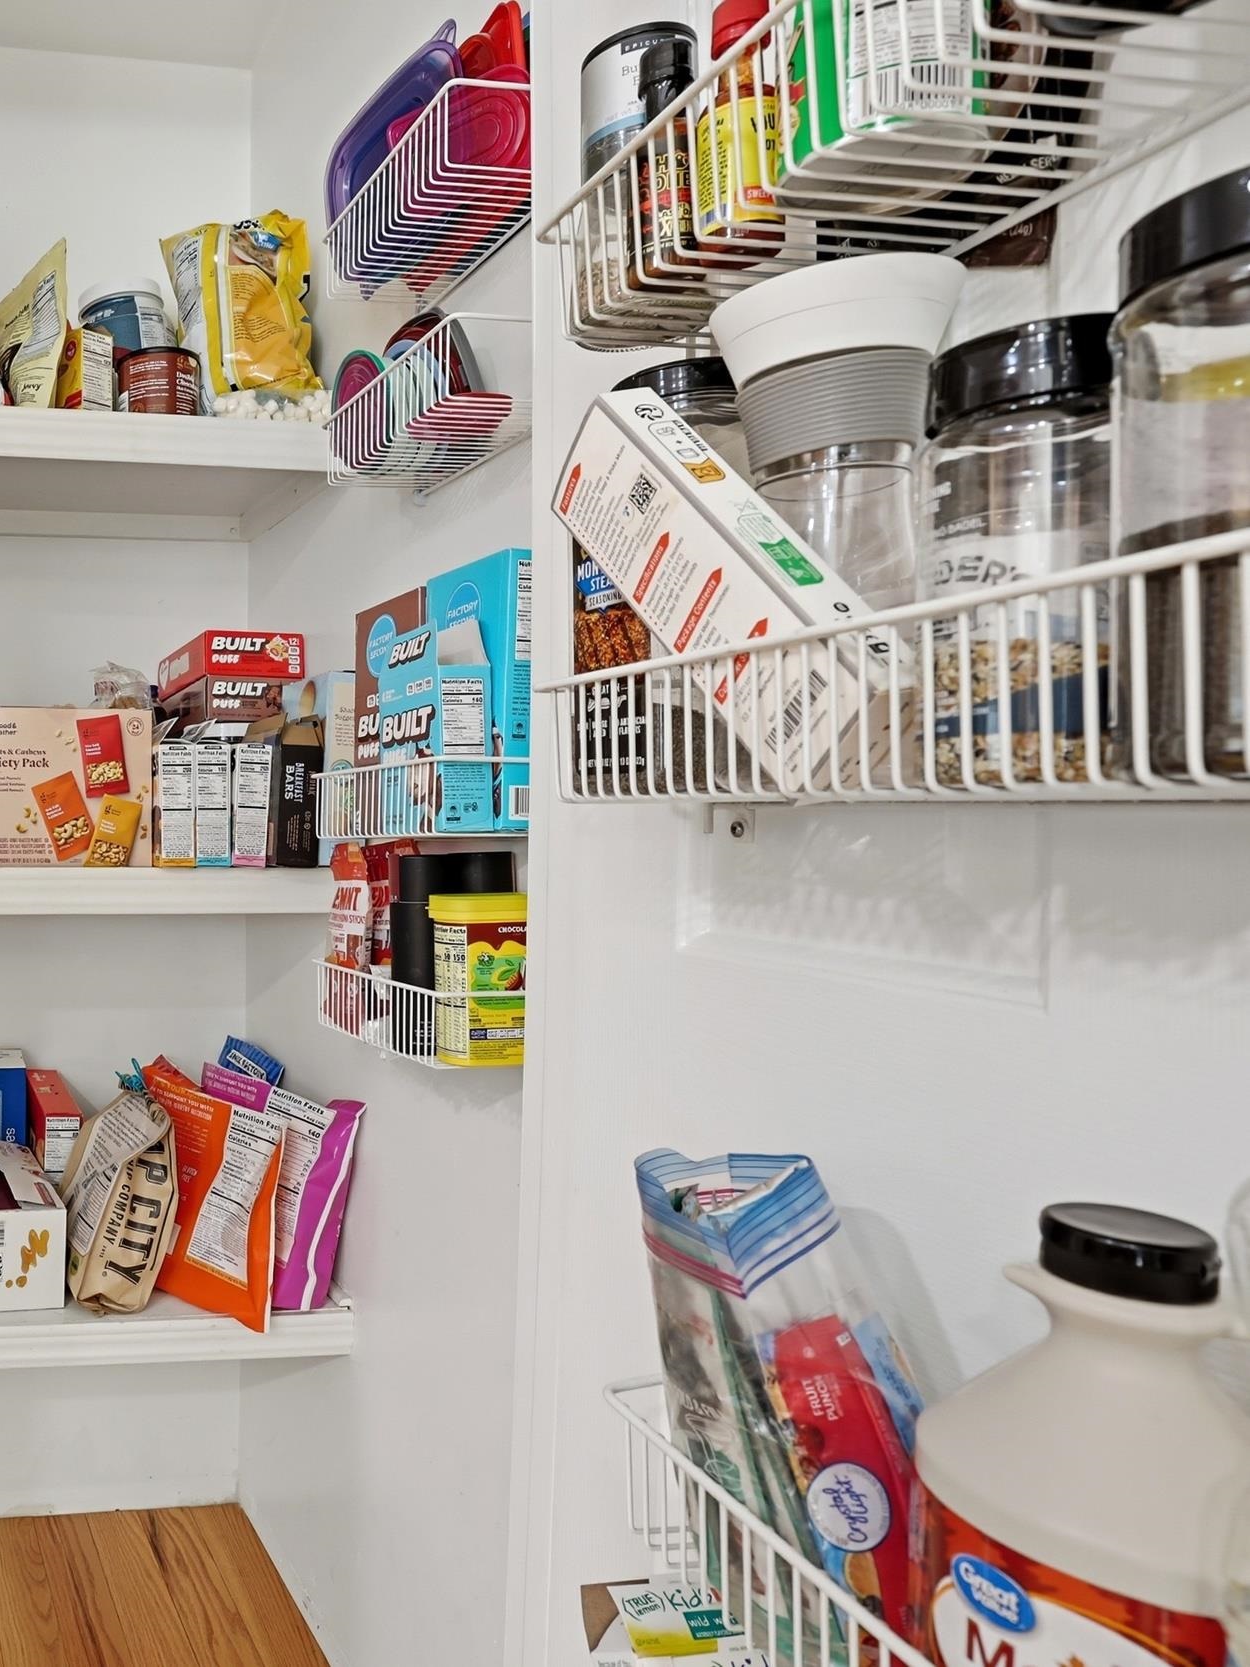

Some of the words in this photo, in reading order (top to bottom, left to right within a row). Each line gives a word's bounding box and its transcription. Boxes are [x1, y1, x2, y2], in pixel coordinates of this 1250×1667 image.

[560, 477, 578, 509] Features
[633, 545, 665, 597] Specifications
[589, 575, 611, 592] STEA
[447, 599, 479, 619] FACTORY
[589, 591, 623, 608] SEASONING
[675, 614, 698, 648] Package
[693, 578, 717, 615] Contents
[211, 636, 266, 652] BUILT
[388, 631, 431, 667] BUILT
[211, 653, 240, 664] PUFF
[212, 681, 267, 697] BUILT
[212, 698, 241, 709] PUFF
[382, 704, 434, 745] BUILT
[14, 748, 47, 756] Cashews
[22, 757, 50, 768] Pack
[284, 764, 295, 800] BARS
[294, 762, 305, 803] BREAKFAST
[272, 1088, 303, 1106] Nutrition
[303, 1100, 326, 1116] Facts
[232, 1109, 265, 1127] Nutrition
[227, 1133, 252, 1148] Calories
[102, 1184, 132, 1246] COMPANY
[105, 1193, 163, 1286] CITY
[802, 1378, 824, 1417] FRUIT
[814, 1374, 839, 1422] PUNCH
[822, 1487, 869, 1543] Crystal
[958, 1561, 1020, 1609] Great
[625, 1592, 655, 1610] TRUE
[636, 1602, 661, 1617] lemon
[687, 1617, 711, 1628] wild
